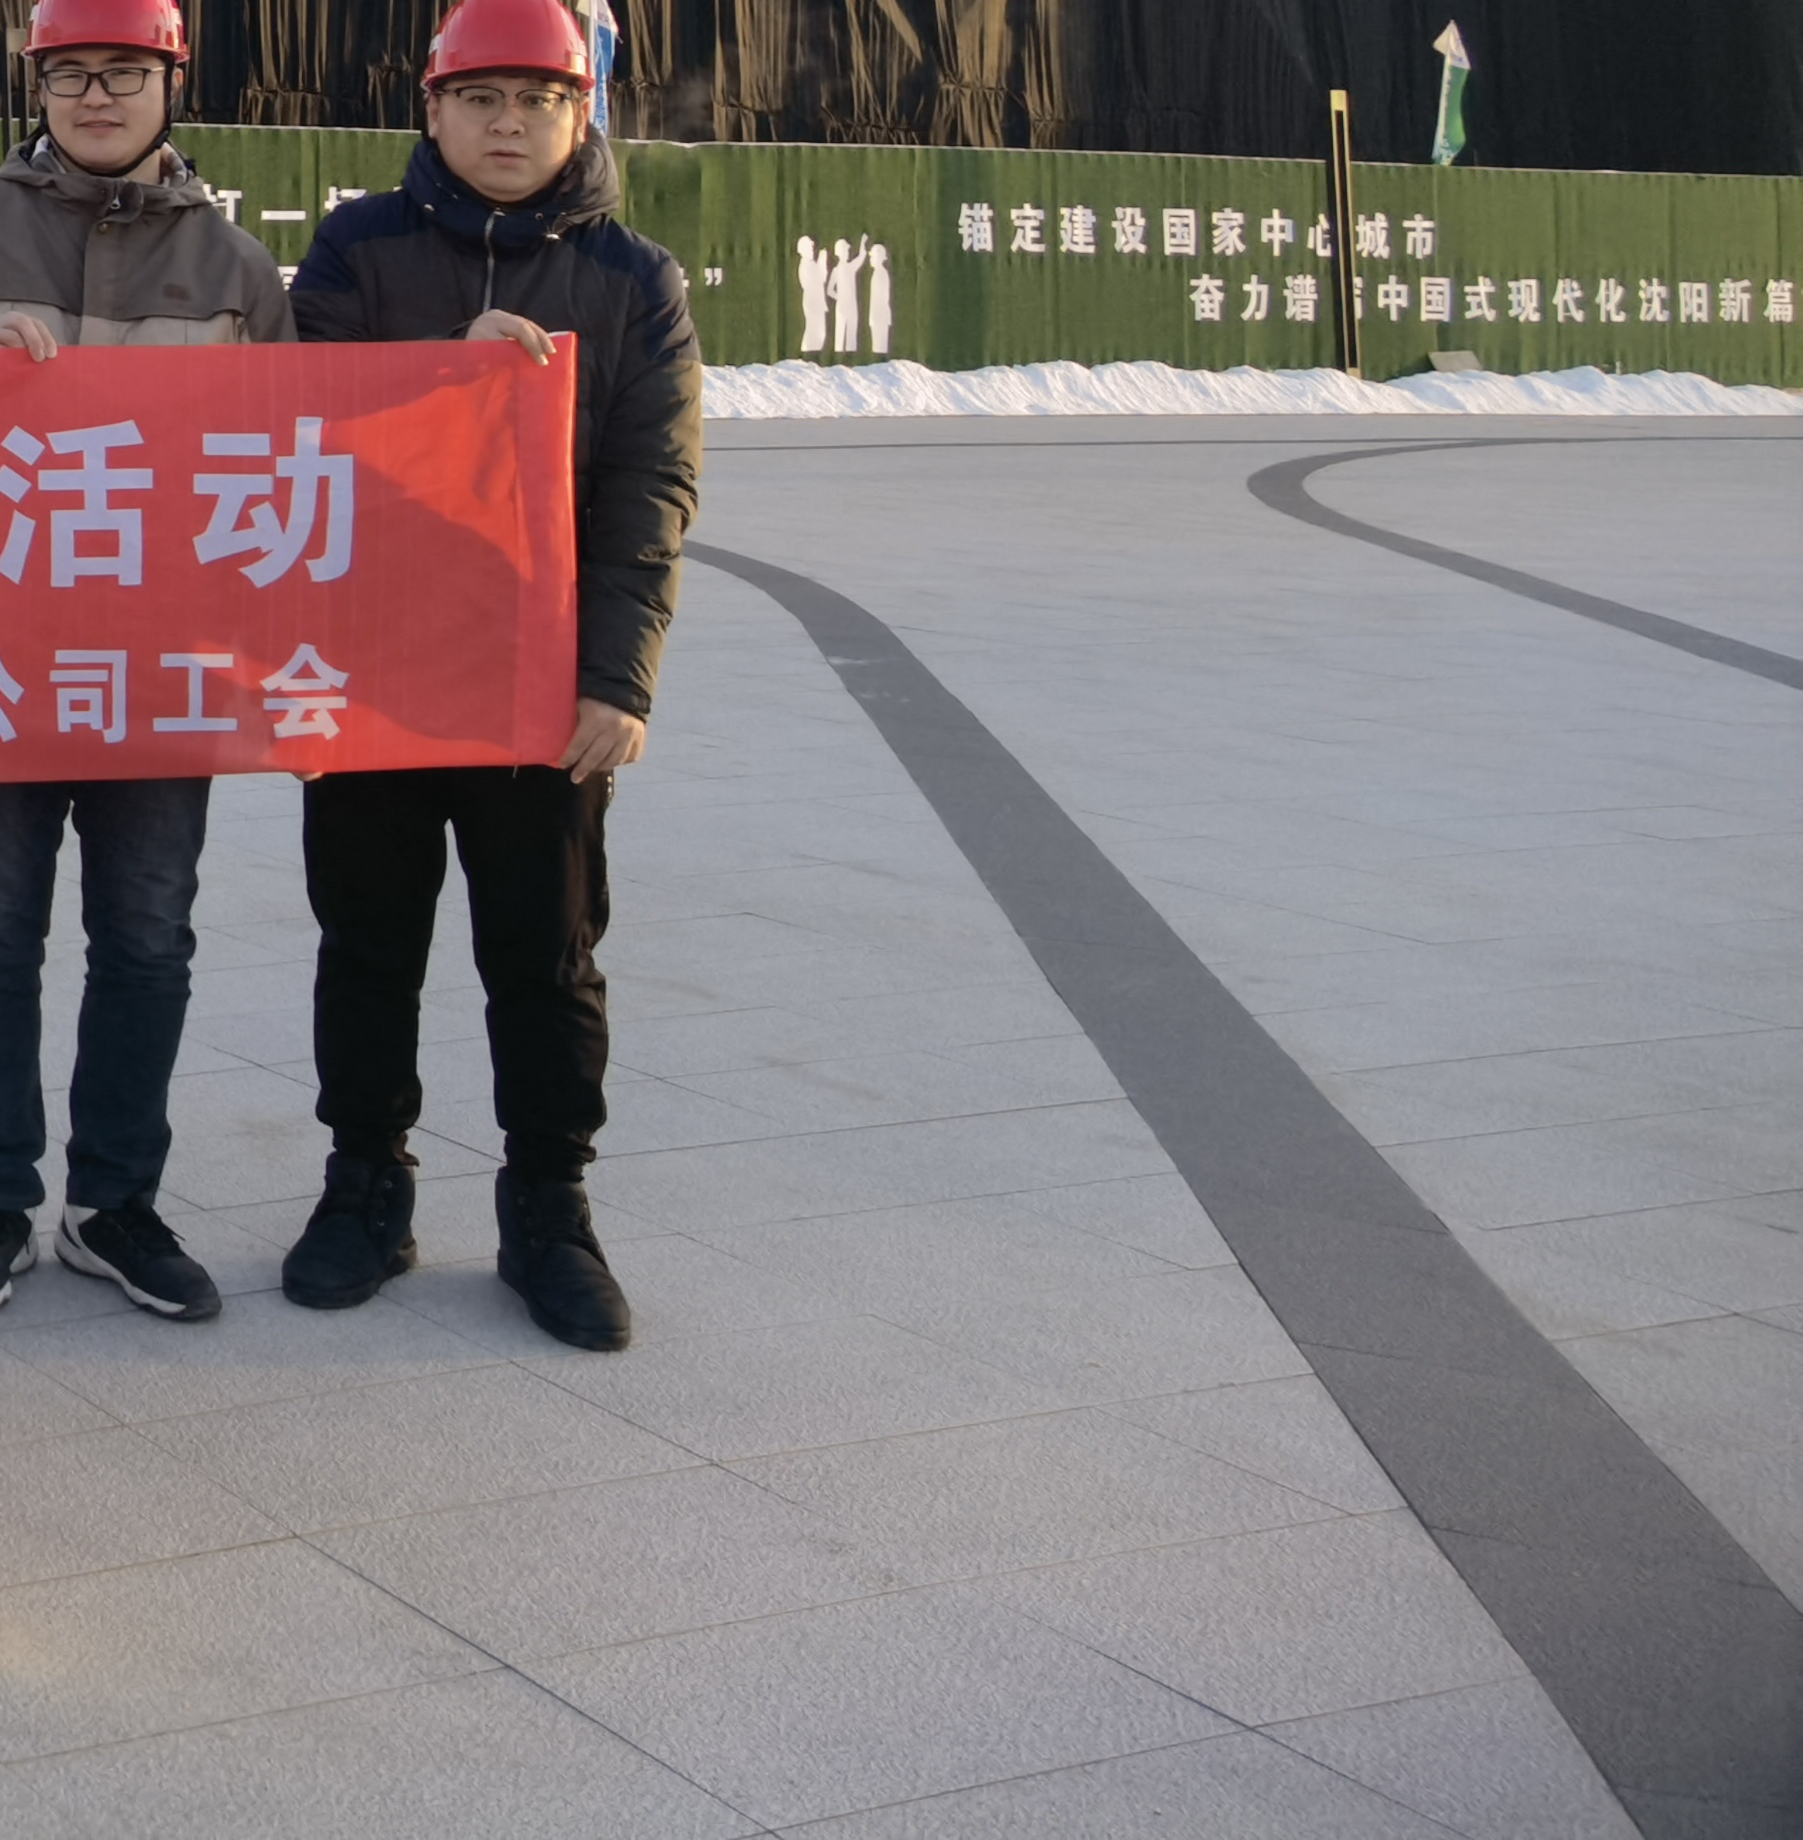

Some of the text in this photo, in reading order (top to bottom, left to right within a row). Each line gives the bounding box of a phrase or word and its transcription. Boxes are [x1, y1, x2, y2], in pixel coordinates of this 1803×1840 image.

[958, 203, 1434, 259] 锚定建设国家中心城市
[1190, 273, 1794, 323] 奋力谱中国式现代化沈阳新篇
